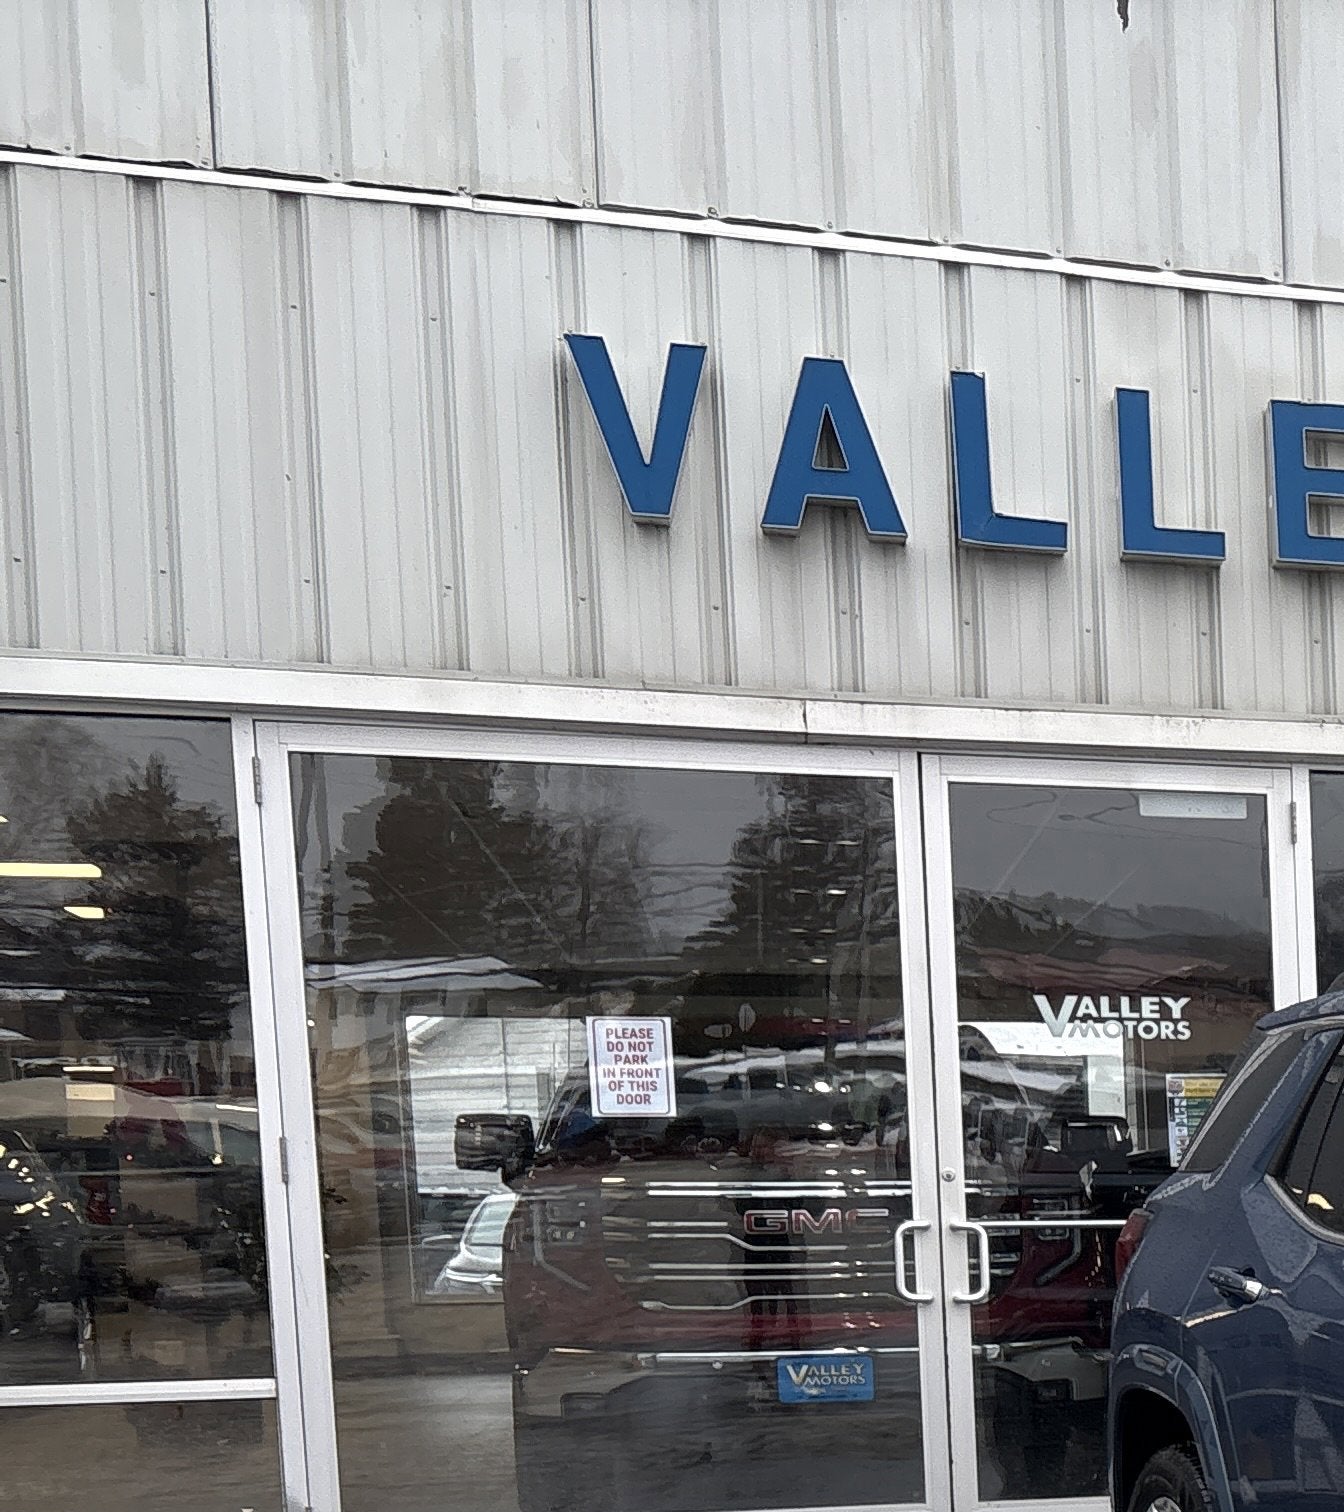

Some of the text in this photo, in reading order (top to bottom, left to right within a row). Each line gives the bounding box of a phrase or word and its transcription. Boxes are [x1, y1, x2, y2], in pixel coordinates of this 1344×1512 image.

[1033, 994, 1191, 1038] VALLEY
[606, 1028, 654, 1039] PLEASE
[1068, 1020, 1191, 1040] MOTORS
[607, 1041, 654, 1052] DO NOT
[614, 1054, 648, 1065] PARK
[603, 1067, 661, 1078] IN FRONT
[608, 1080, 658, 1092] OF THIS
[616, 1093, 651, 1104] DOOR
[743, 1208, 890, 1235] GMC
[786, 1363, 865, 1386] VALLEY
[803, 1375, 866, 1386] MOTORS
